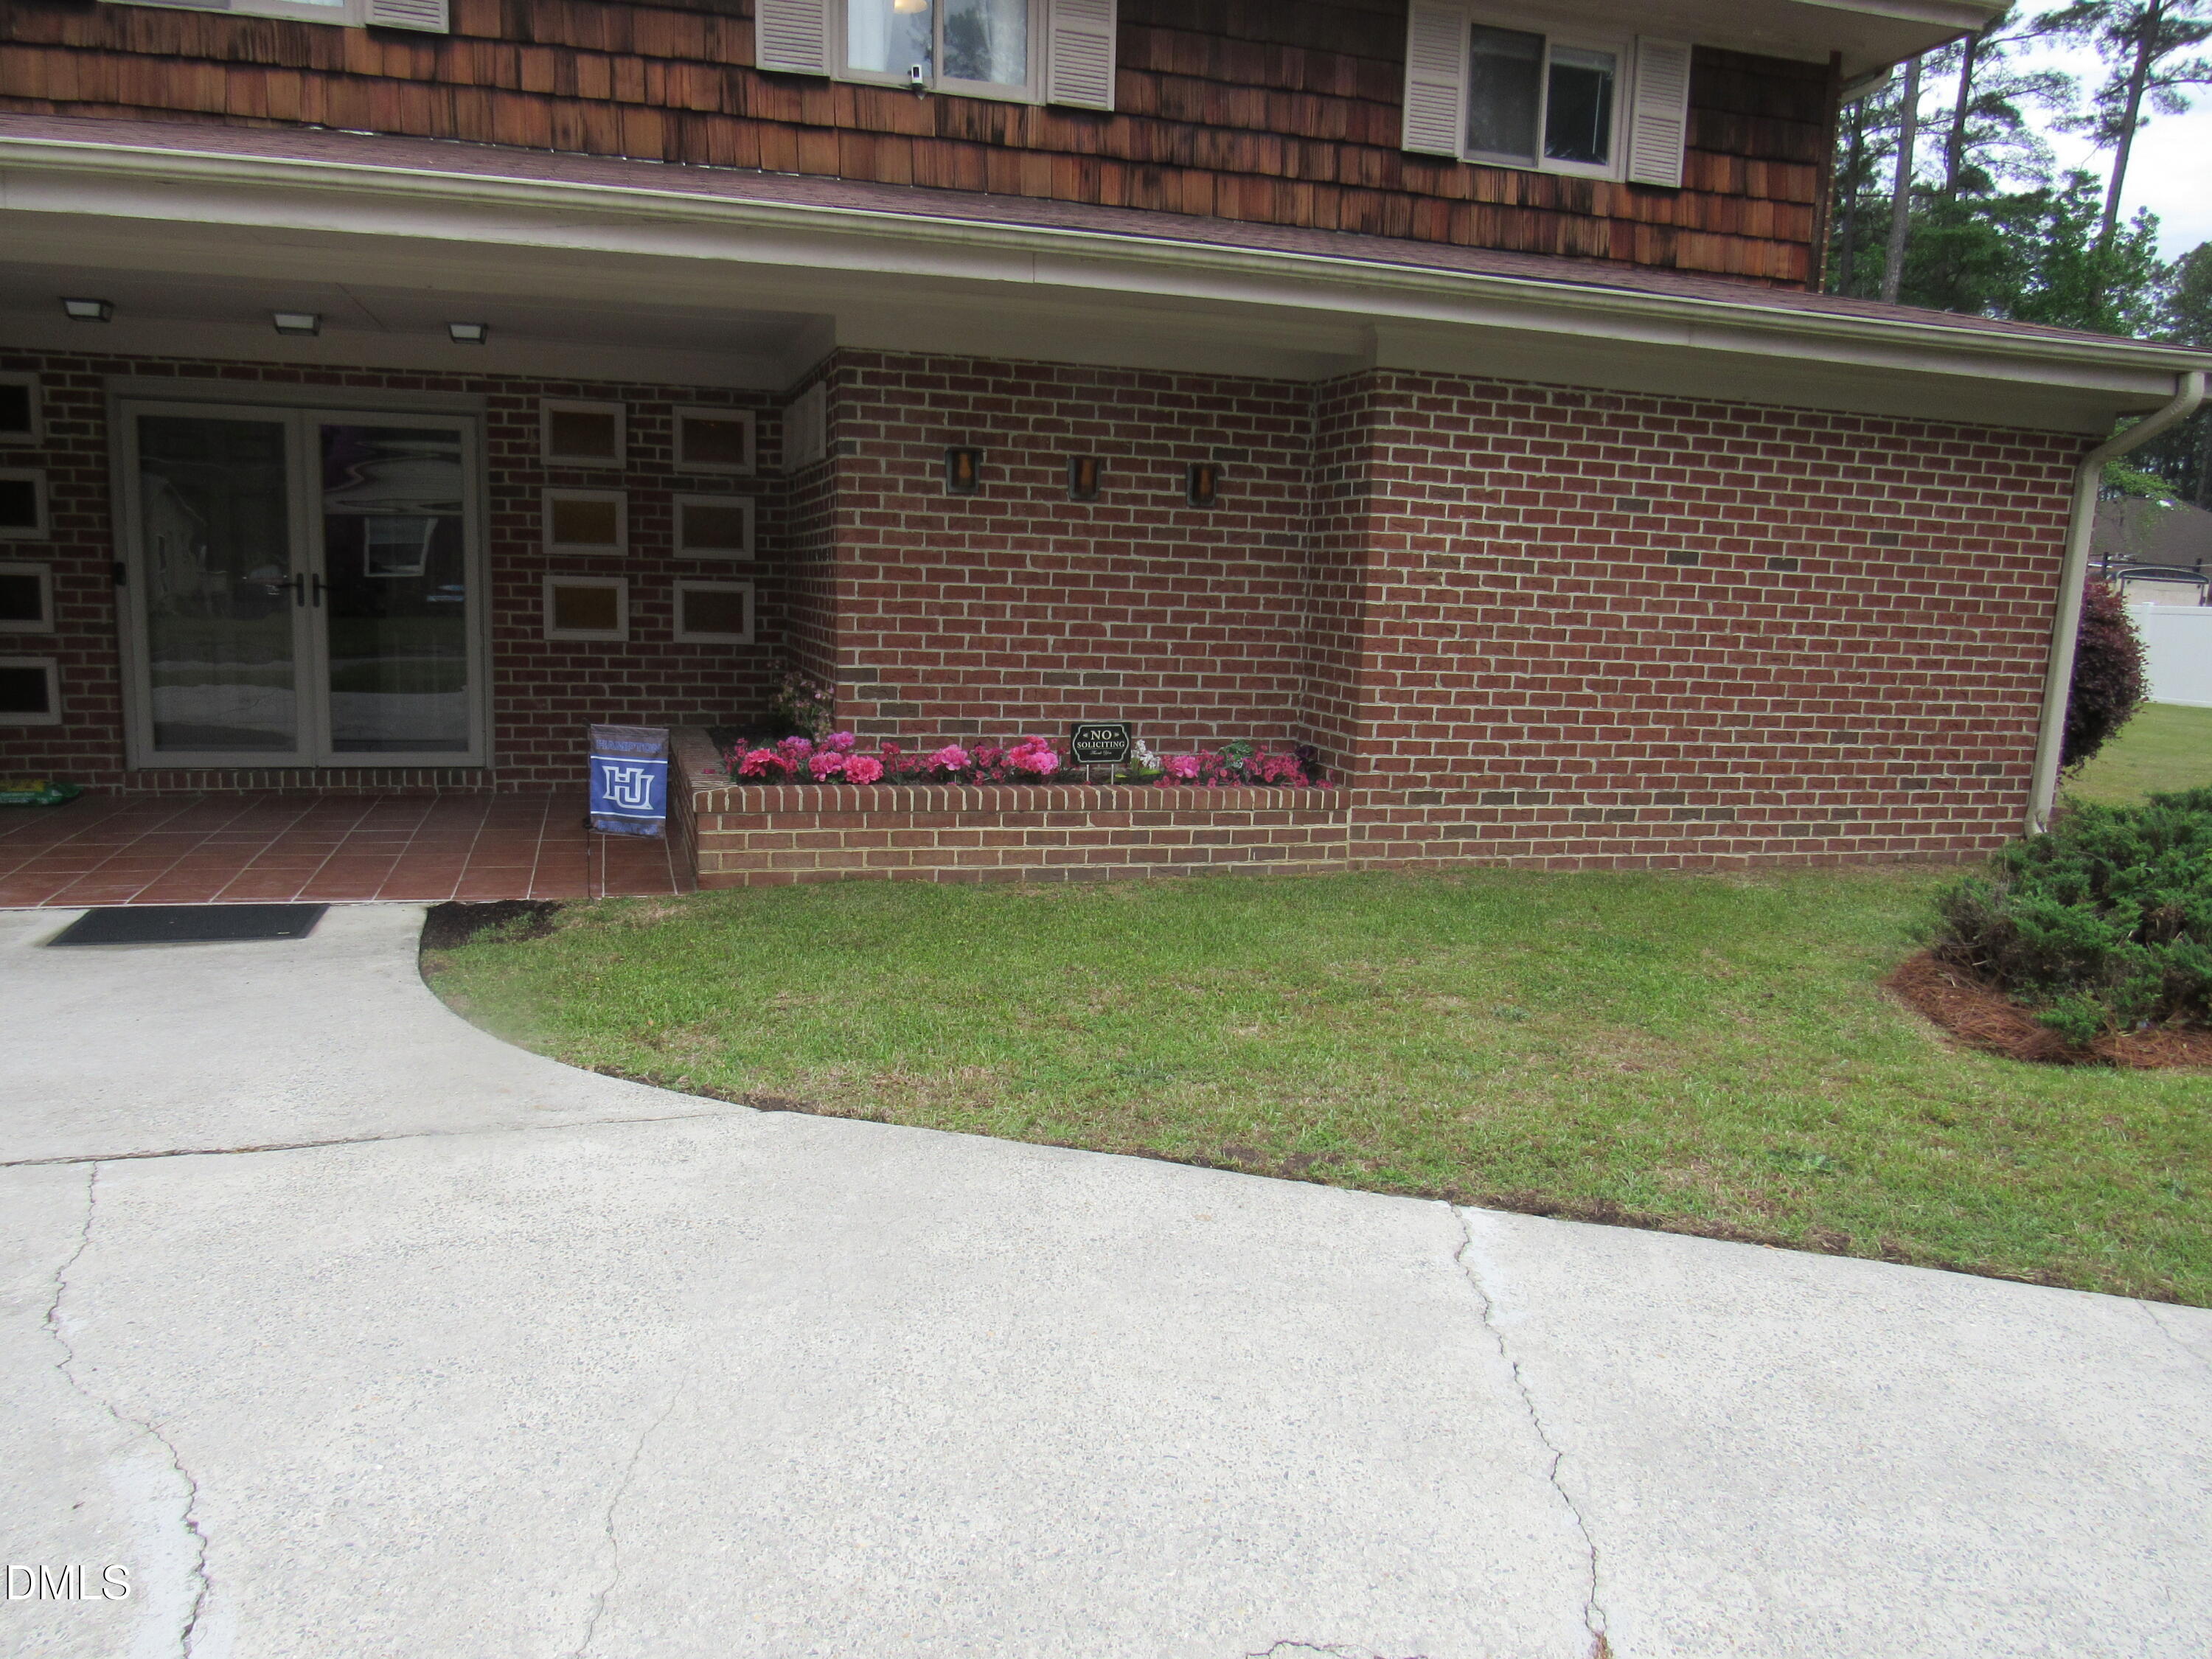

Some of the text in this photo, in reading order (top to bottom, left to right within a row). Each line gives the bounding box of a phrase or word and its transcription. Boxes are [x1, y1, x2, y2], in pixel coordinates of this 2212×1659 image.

[1091, 730, 1112, 740] NO
[596, 739, 661, 753] HAMPTON
[602, 765, 655, 810] HU
